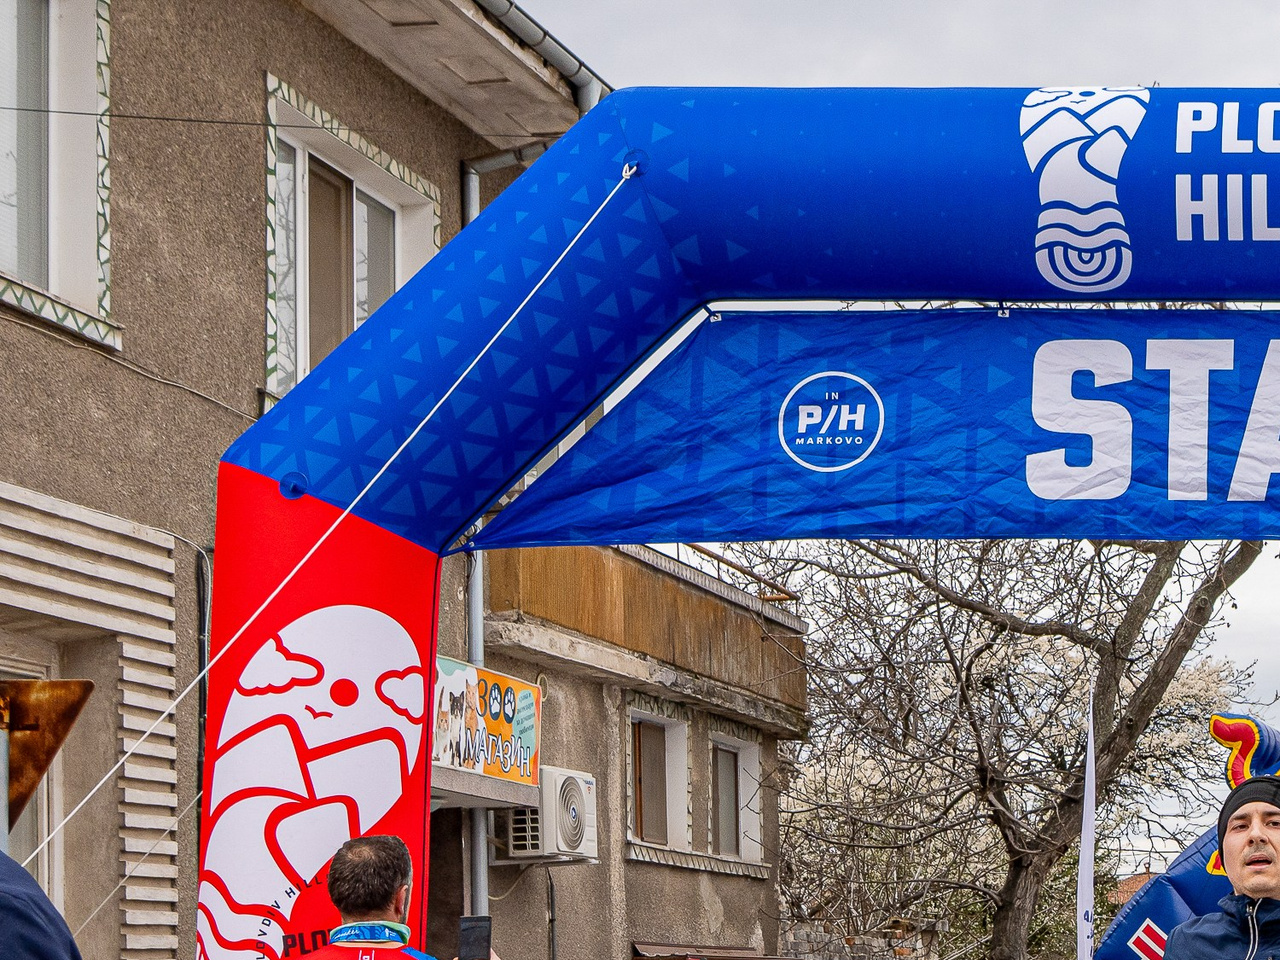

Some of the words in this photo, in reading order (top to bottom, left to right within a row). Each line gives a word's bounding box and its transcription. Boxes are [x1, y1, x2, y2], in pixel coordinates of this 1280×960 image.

[825, 392, 839, 400] IN
[798, 404, 866, 434] P/H
[795, 436, 863, 445] MARKOVO
[465, 727, 532, 777] МАГАЗИН
[284, 873, 330, 899] HILL
[281, 928, 333, 958] PLO
